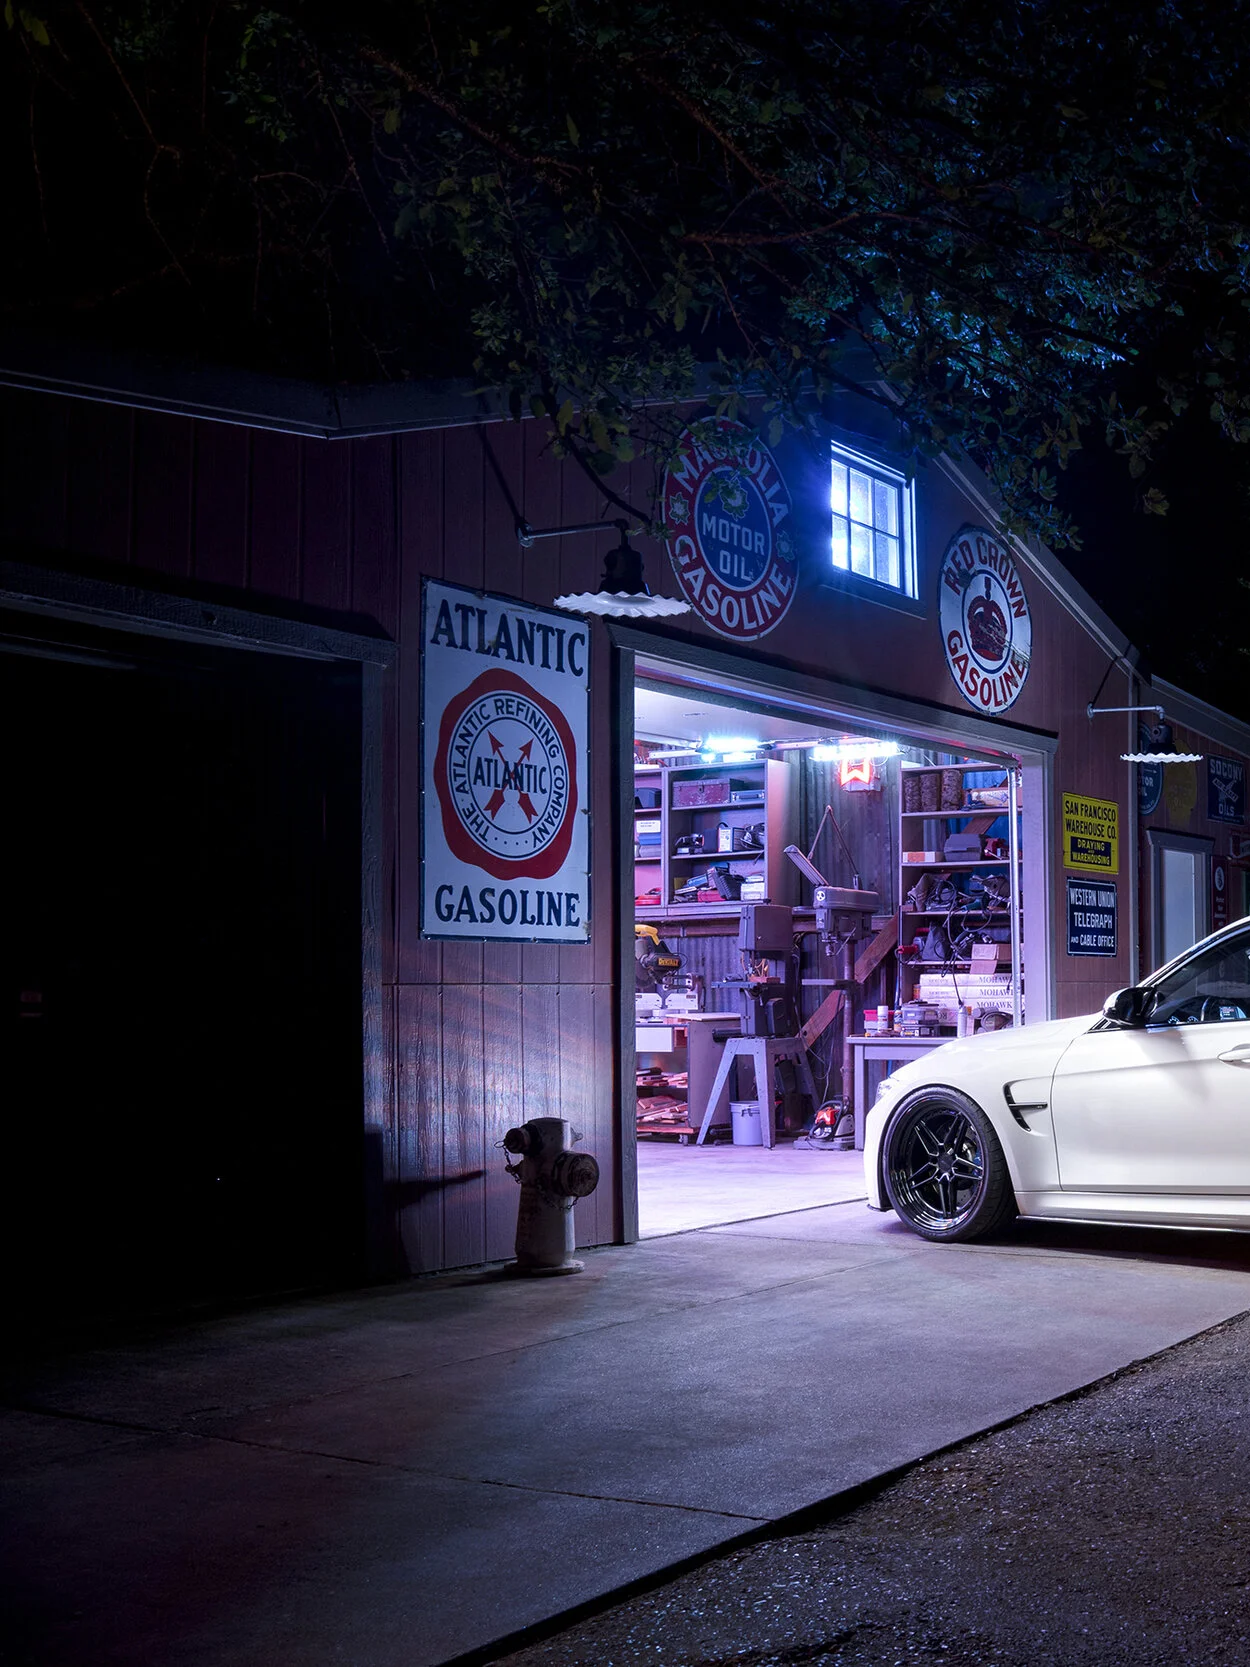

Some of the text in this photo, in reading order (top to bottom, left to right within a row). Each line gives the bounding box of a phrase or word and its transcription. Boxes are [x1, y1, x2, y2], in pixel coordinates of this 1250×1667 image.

[672, 428, 790, 528] MAGOLIA
[702, 512, 766, 556] MOTOR
[719, 550, 754, 582] OIL
[976, 536, 1027, 619] CROWN
[675, 535, 792, 631] GASOLINE
[430, 599, 586, 677] ATLANTIC
[947, 630, 1026, 707] GASOLINE
[453, 699, 565, 849] THE ATLANTIC REFINING COMPANY
[473, 756, 548, 795] ATLANTIC
[1210, 758, 1243, 782] SOCONY
[1065, 801, 1117, 822] SAN FRANCISCO
[1066, 818, 1117, 840] WAREHOUSE CO.
[1077, 839, 1105, 851] DRAYING
[1072, 851, 1110, 865] WAREHOUSING
[435, 884, 581, 927] GASOLINE
[1070, 888, 1115, 908] WESTERN UNION
[1074, 912, 1113, 929] TELEGRAPH
[1080, 934, 1097, 947] CABLE
[1098, 936, 1115, 947] OFFICE
[979, 975, 1012, 983] MOHAW
